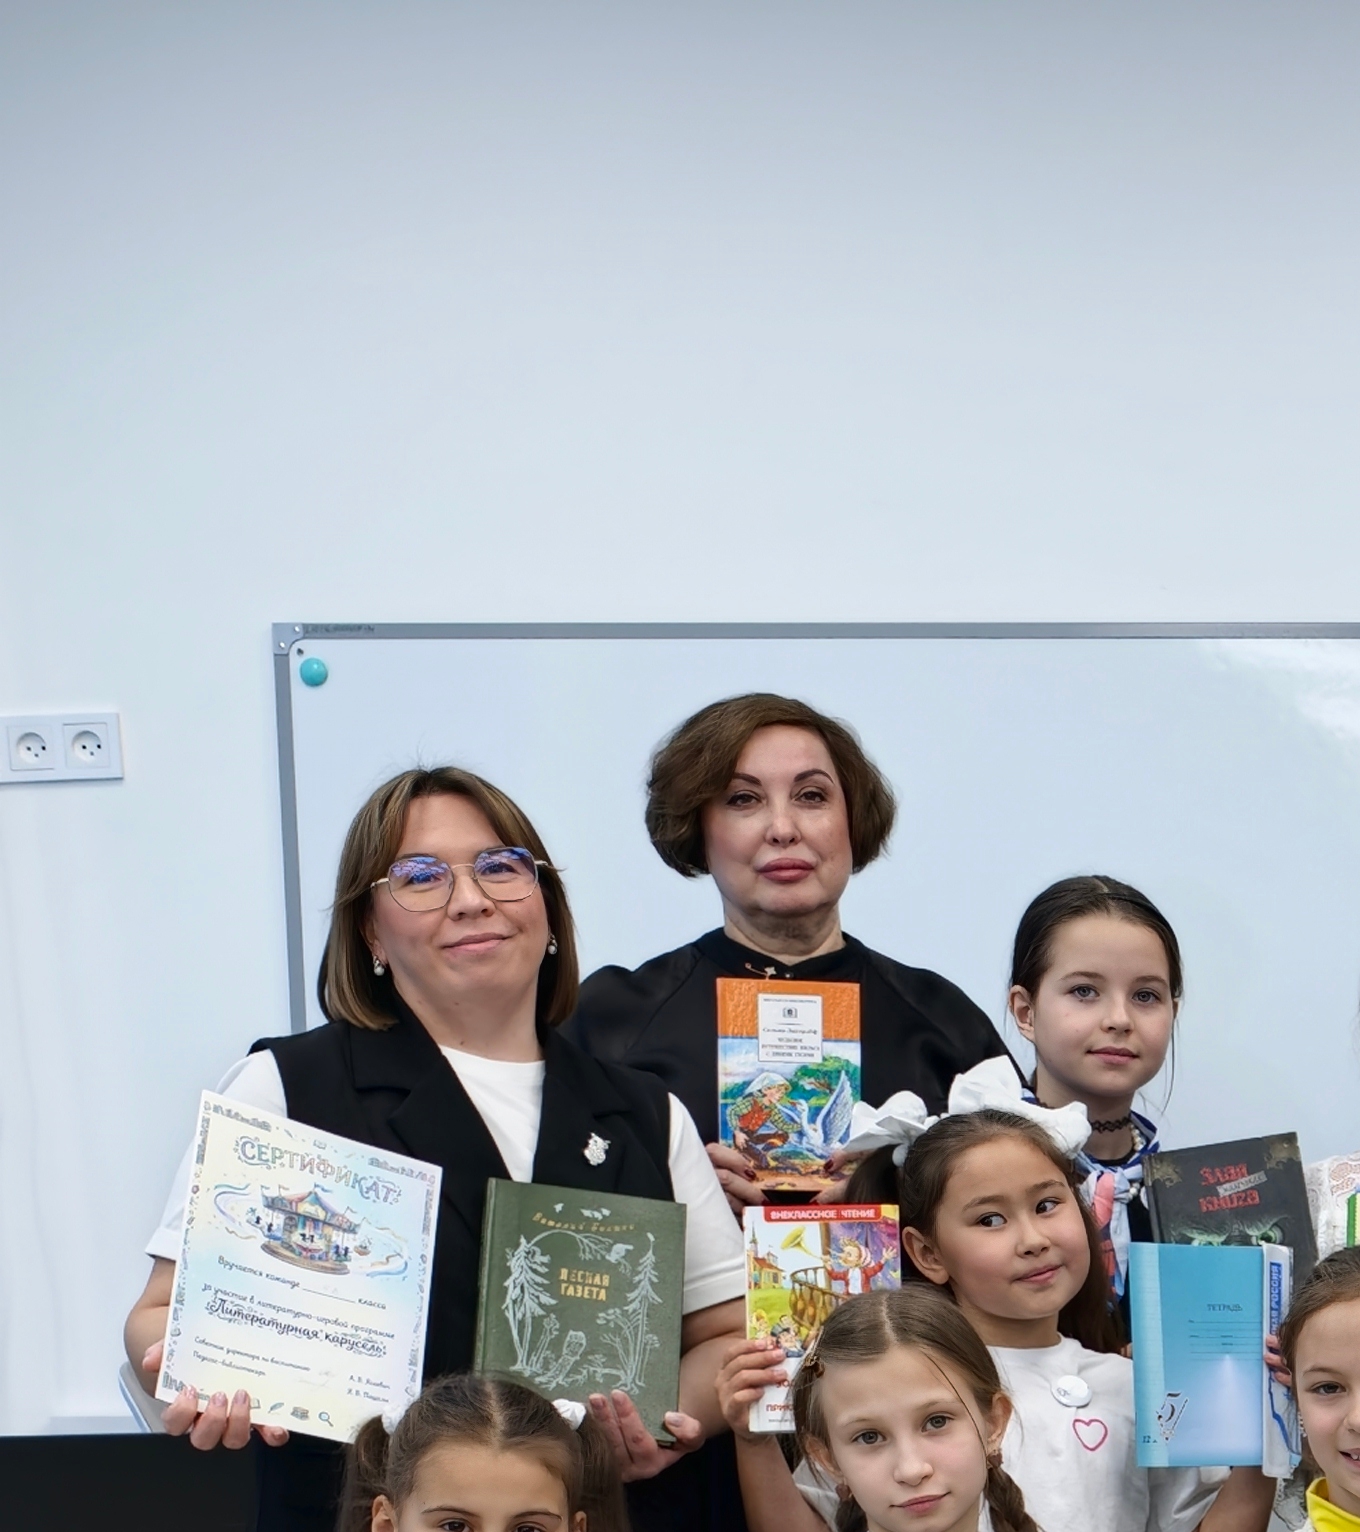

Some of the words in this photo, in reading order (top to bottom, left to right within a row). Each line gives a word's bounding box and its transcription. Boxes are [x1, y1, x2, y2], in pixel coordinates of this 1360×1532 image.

[239, 1138, 399, 1204] СЕРТИФИКАТ
[769, 1206, 837, 1220] ВНЕКЛАССНОЕ
[841, 1207, 876, 1220] ЧТЕНИЕ
[559, 1268, 610, 1288] ЛЕСНАЯ
[560, 1283, 607, 1301] ГАЗЕТА
[1207, 1303, 1243, 1312] ТЕТРАДЬ
[209, 1297, 320, 1341] Литературная
[324, 1331, 383, 1355] карусель
